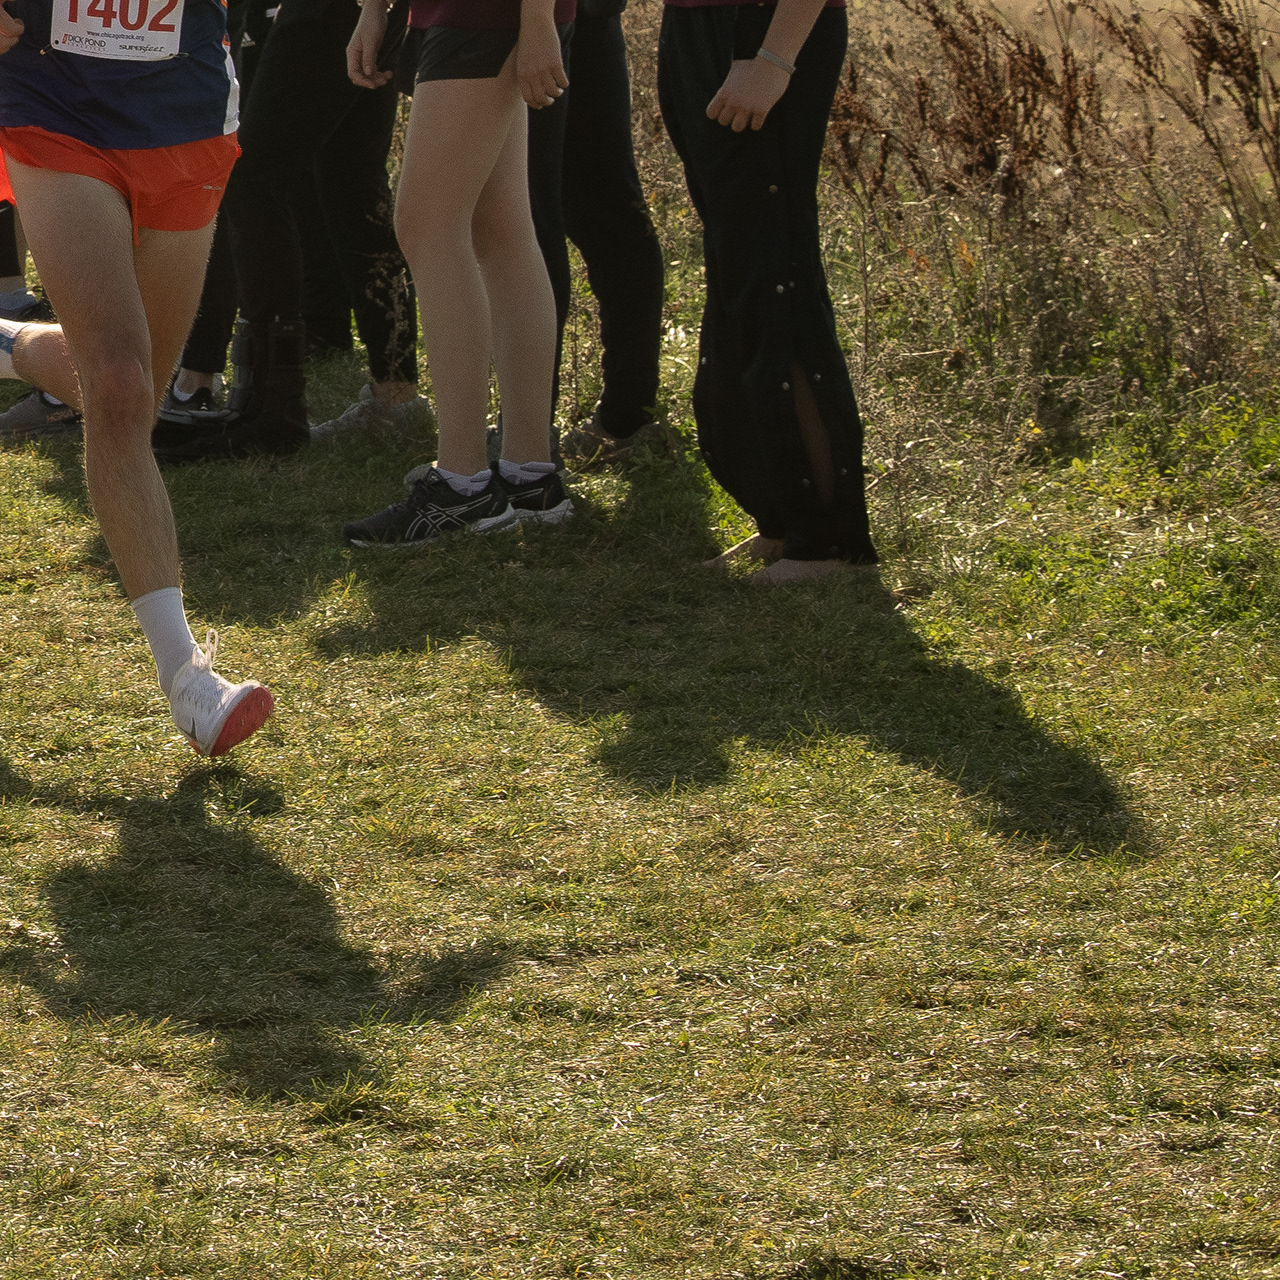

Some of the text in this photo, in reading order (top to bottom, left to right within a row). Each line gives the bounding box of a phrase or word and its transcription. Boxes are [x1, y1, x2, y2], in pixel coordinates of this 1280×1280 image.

[68, 34, 84, 45] DICK
[83, 37, 106, 48] POND
[87, 30, 145, 41] www.chicagotrack.org
